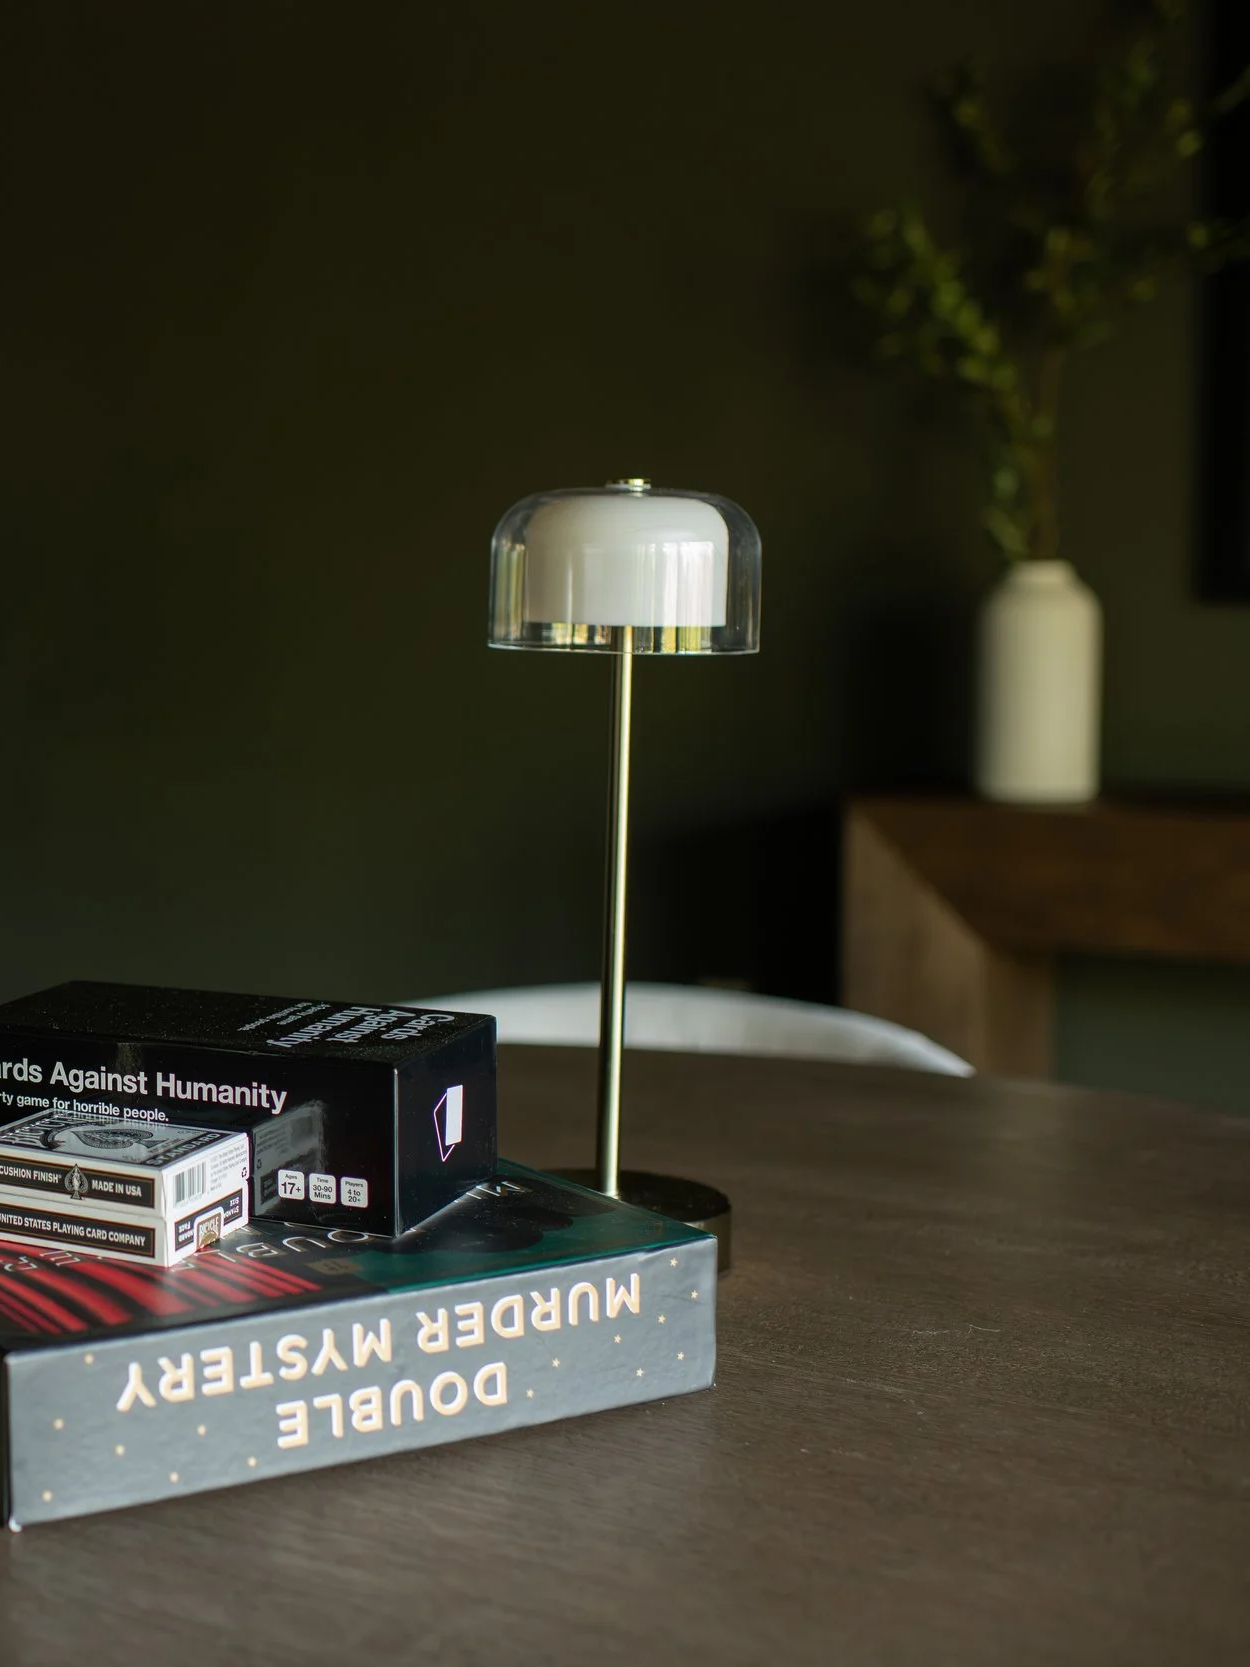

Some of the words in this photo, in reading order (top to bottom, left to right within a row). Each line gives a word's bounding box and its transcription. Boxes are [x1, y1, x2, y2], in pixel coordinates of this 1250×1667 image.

[265, 1006, 382, 1048] Humanity
[325, 1009, 416, 1043] Against
[381, 1014, 455, 1040] Cards
[49, 1061, 148, 1095] Against
[156, 1071, 288, 1115] Humanity
[17, 1094, 50, 1108] game
[52, 1097, 71, 1110] for
[73, 1099, 120, 1116] horrible
[123, 1107, 169, 1122] people.
[145, 1133, 222, 1165] STANDARD
[91, 1179, 114, 1193] MADE
[115, 1183, 124, 1194] IN
[125, 1184, 142, 1197] USA
[281, 1181, 302, 1195] 17+
[312, 1184, 333, 1193] 30-90
[314, 1192, 332, 1200] Mins
[345, 1180, 364, 1188] Players
[24, 1218, 51, 1231] STATES
[52, 1223, 85, 1237] PLAYING
[85, 1228, 107, 1240] CARD
[108, 1231, 146, 1247] COMPANY
[415, 1272, 642, 1354] MURDER
[116, 1317, 393, 1413] MYSTERY
[276, 1361, 508, 1449] DOUBLE
